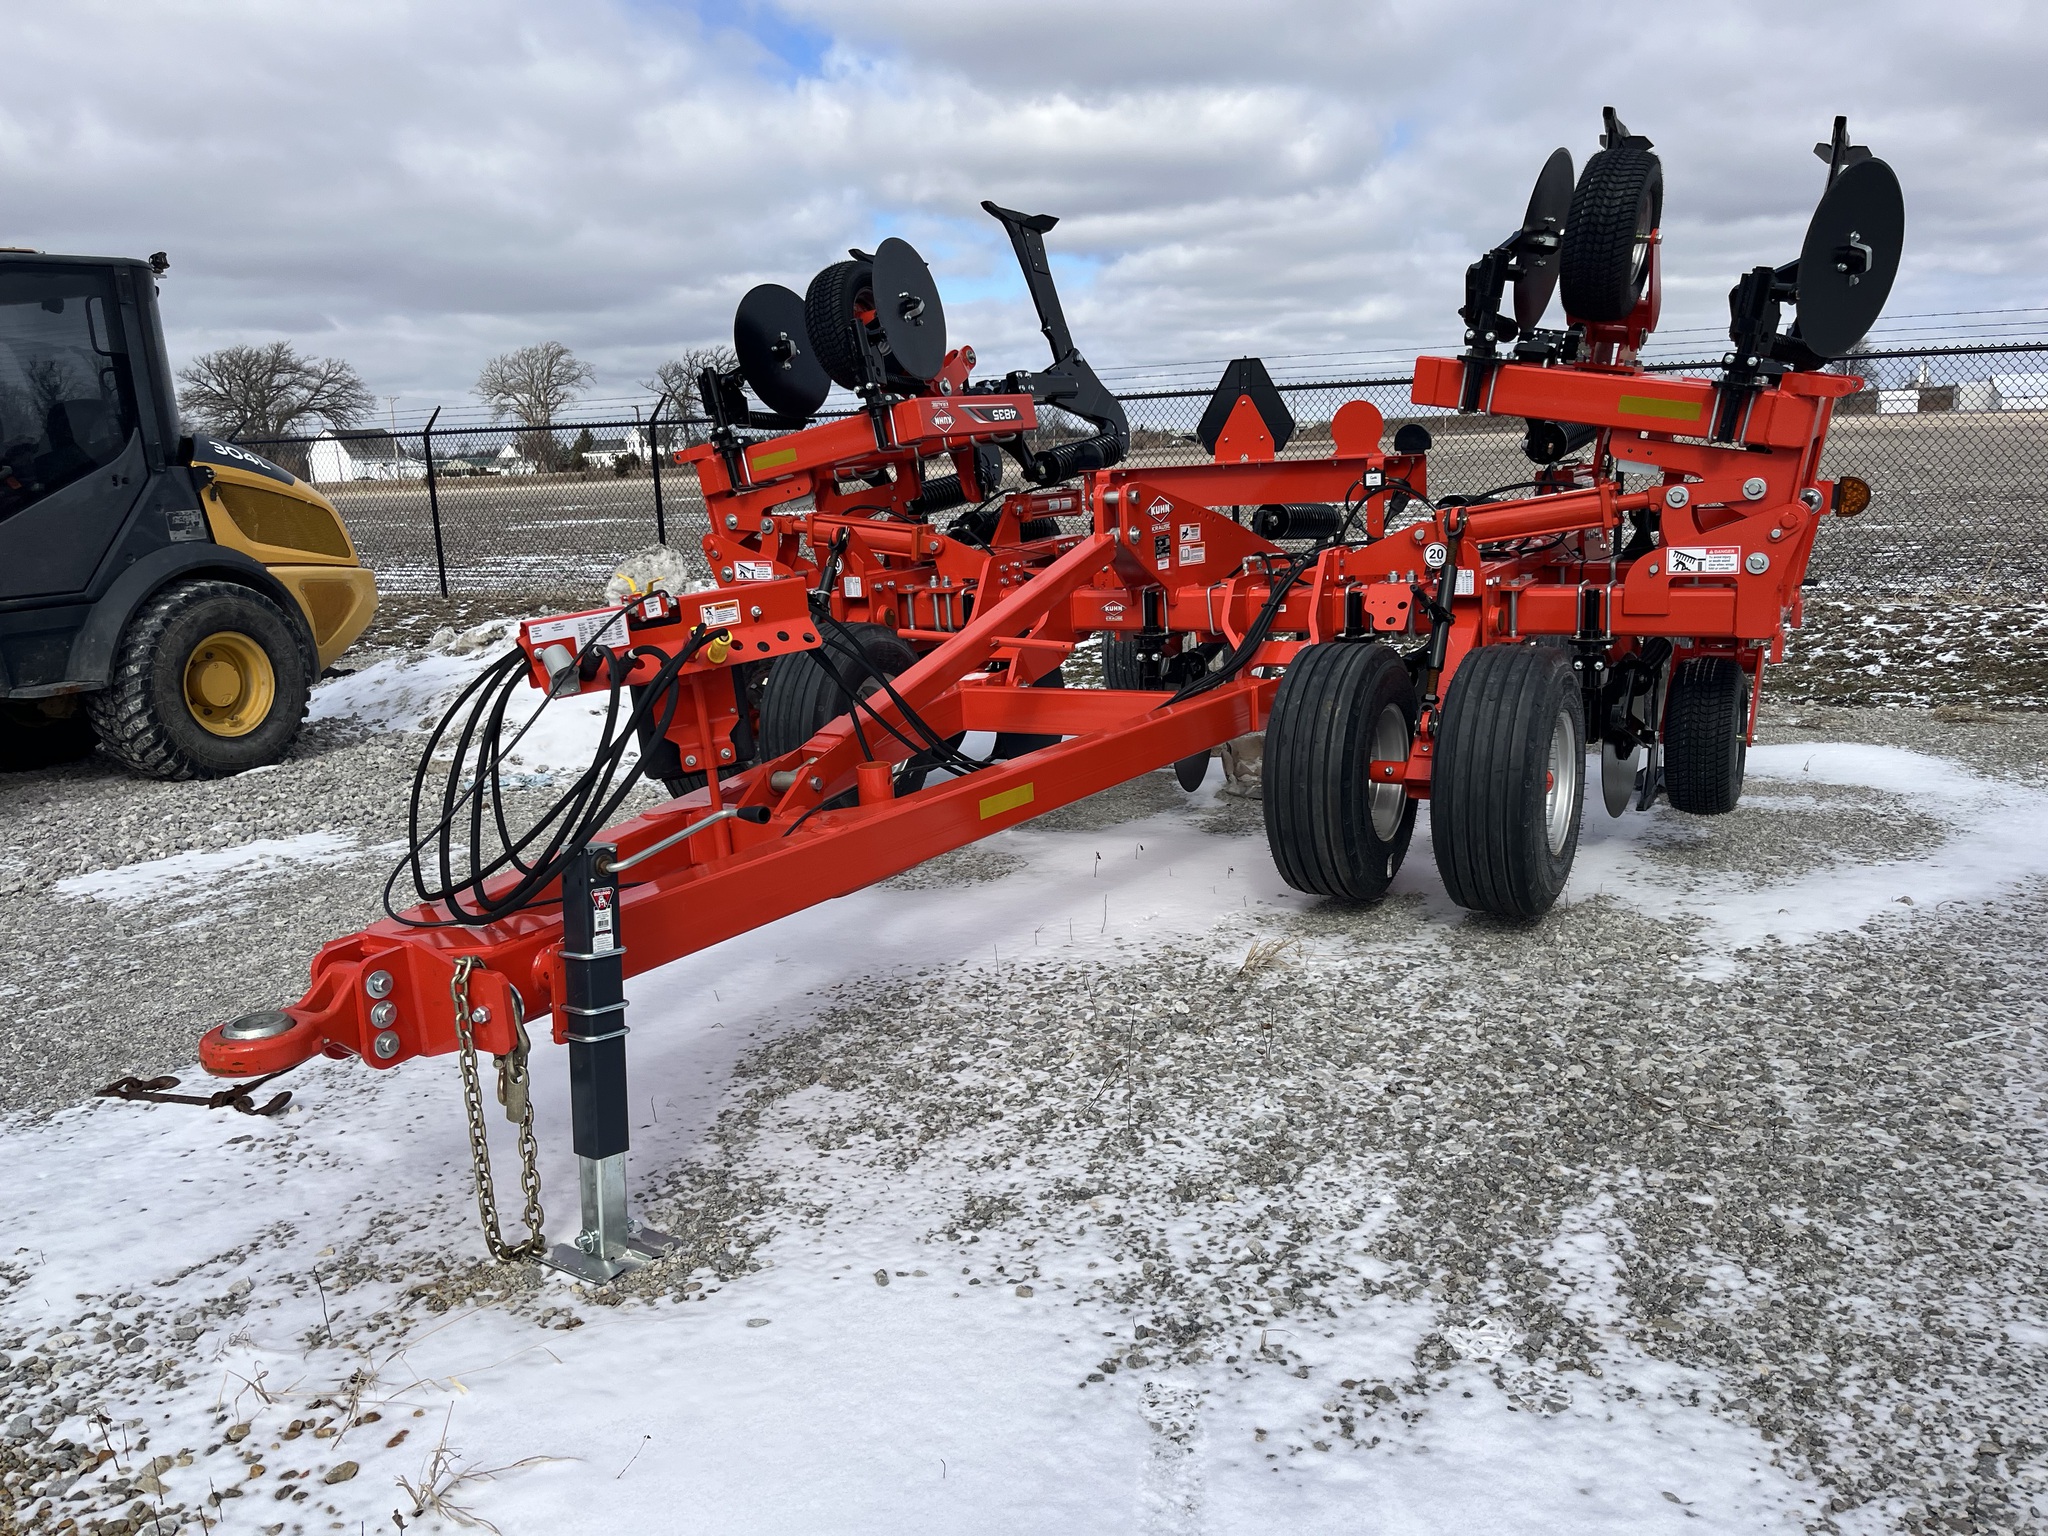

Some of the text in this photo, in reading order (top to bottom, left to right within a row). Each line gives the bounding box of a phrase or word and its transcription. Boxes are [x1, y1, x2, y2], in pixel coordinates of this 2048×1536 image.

[992, 408, 1017, 420] 4835
[1150, 504, 1170, 515] KUHN
[1429, 549, 1444, 559] 20
